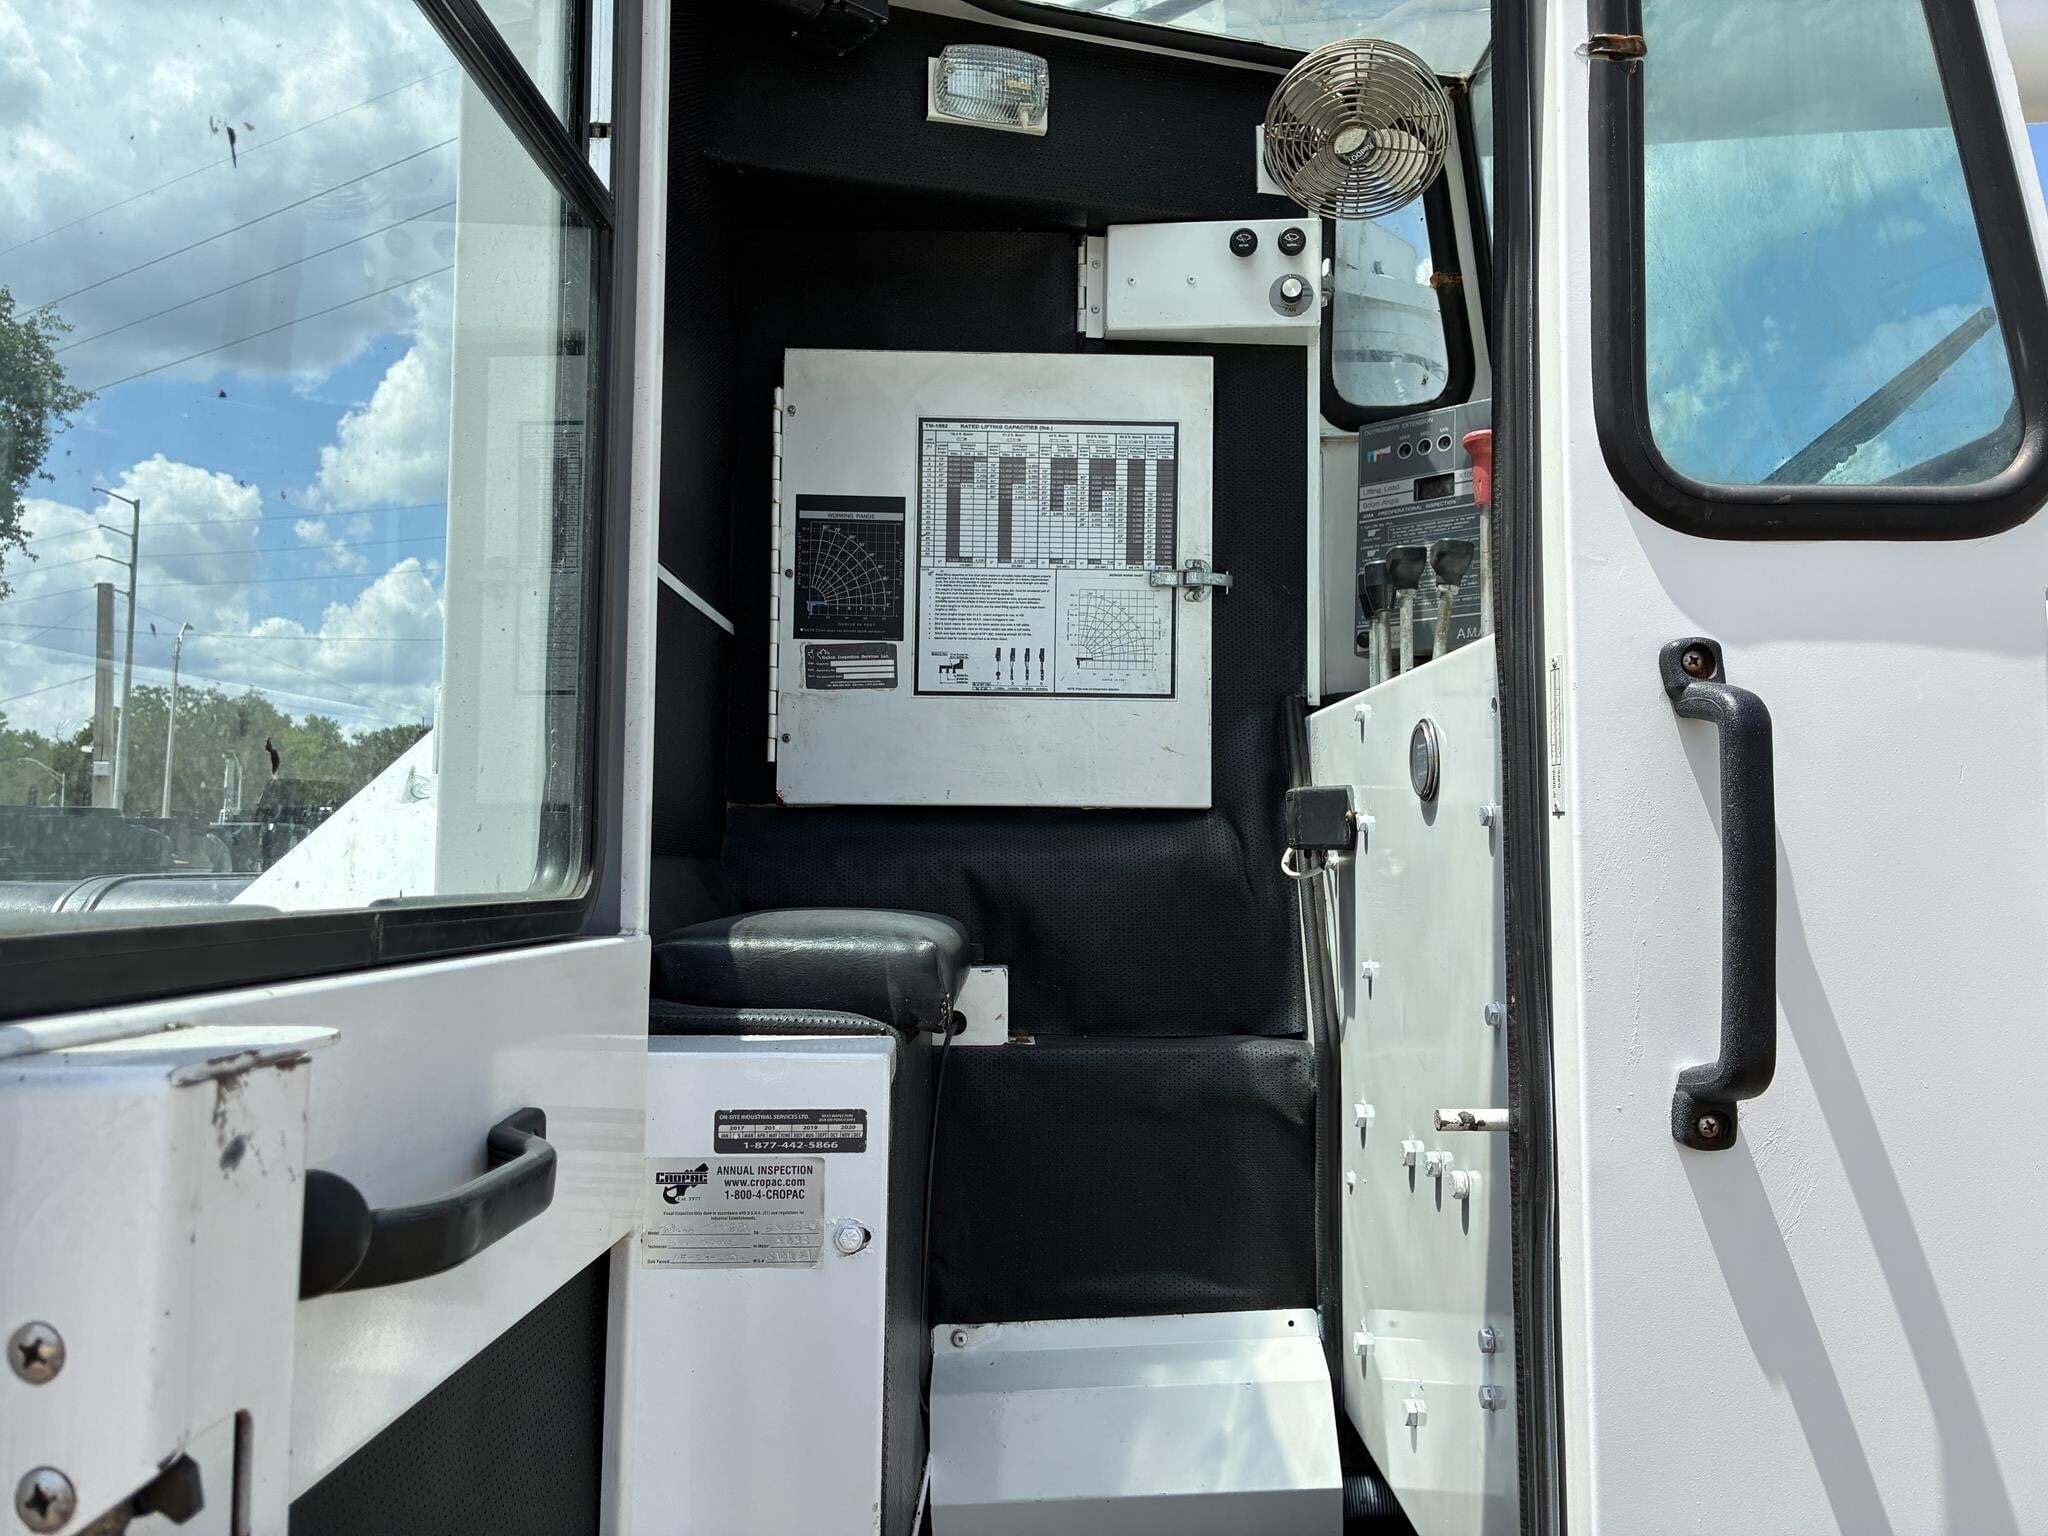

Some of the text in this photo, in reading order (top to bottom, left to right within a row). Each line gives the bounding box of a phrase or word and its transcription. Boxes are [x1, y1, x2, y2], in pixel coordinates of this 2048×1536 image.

[743, 1141, 839, 1149] 1-877-442-5866
[716, 1165, 813, 1176] ANNUAL INSPECTION
[724, 1178, 806, 1188] www.cropac.com
[724, 1189, 806, 1200] 1-800-4-CROPAC
